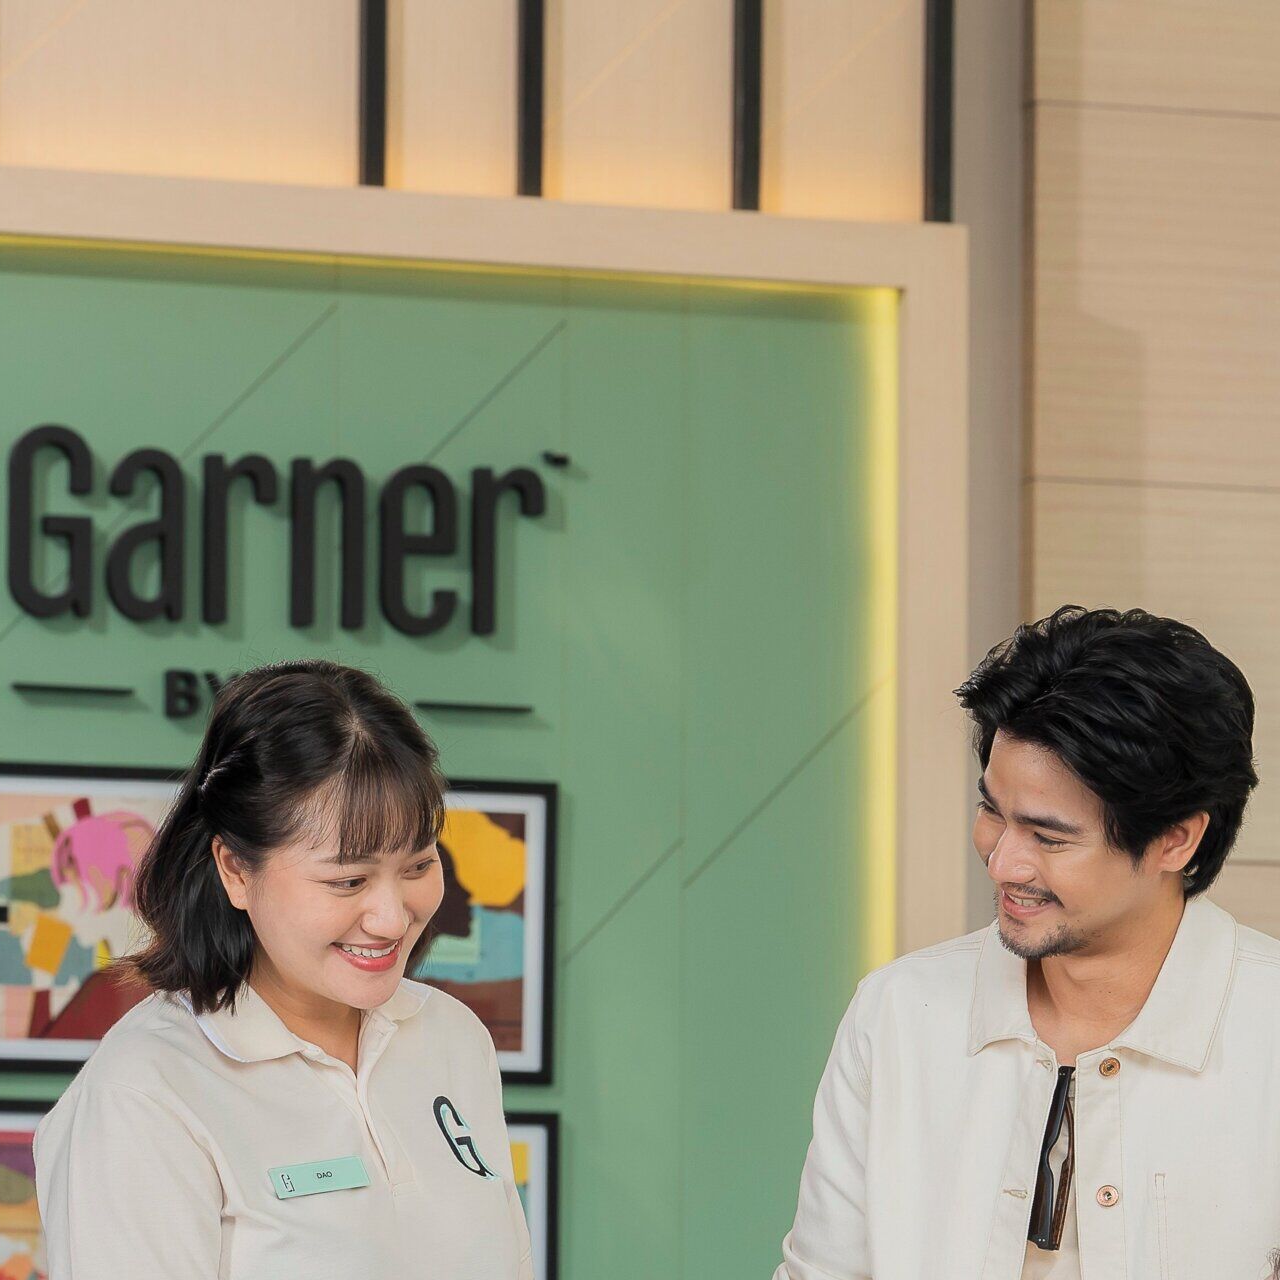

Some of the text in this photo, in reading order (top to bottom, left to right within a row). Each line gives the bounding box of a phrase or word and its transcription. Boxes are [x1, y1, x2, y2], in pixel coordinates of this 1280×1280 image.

[8, 424, 547, 637] Garner
[316, 1171, 333, 1179] DAO
[432, 1095, 498, 1179] G
